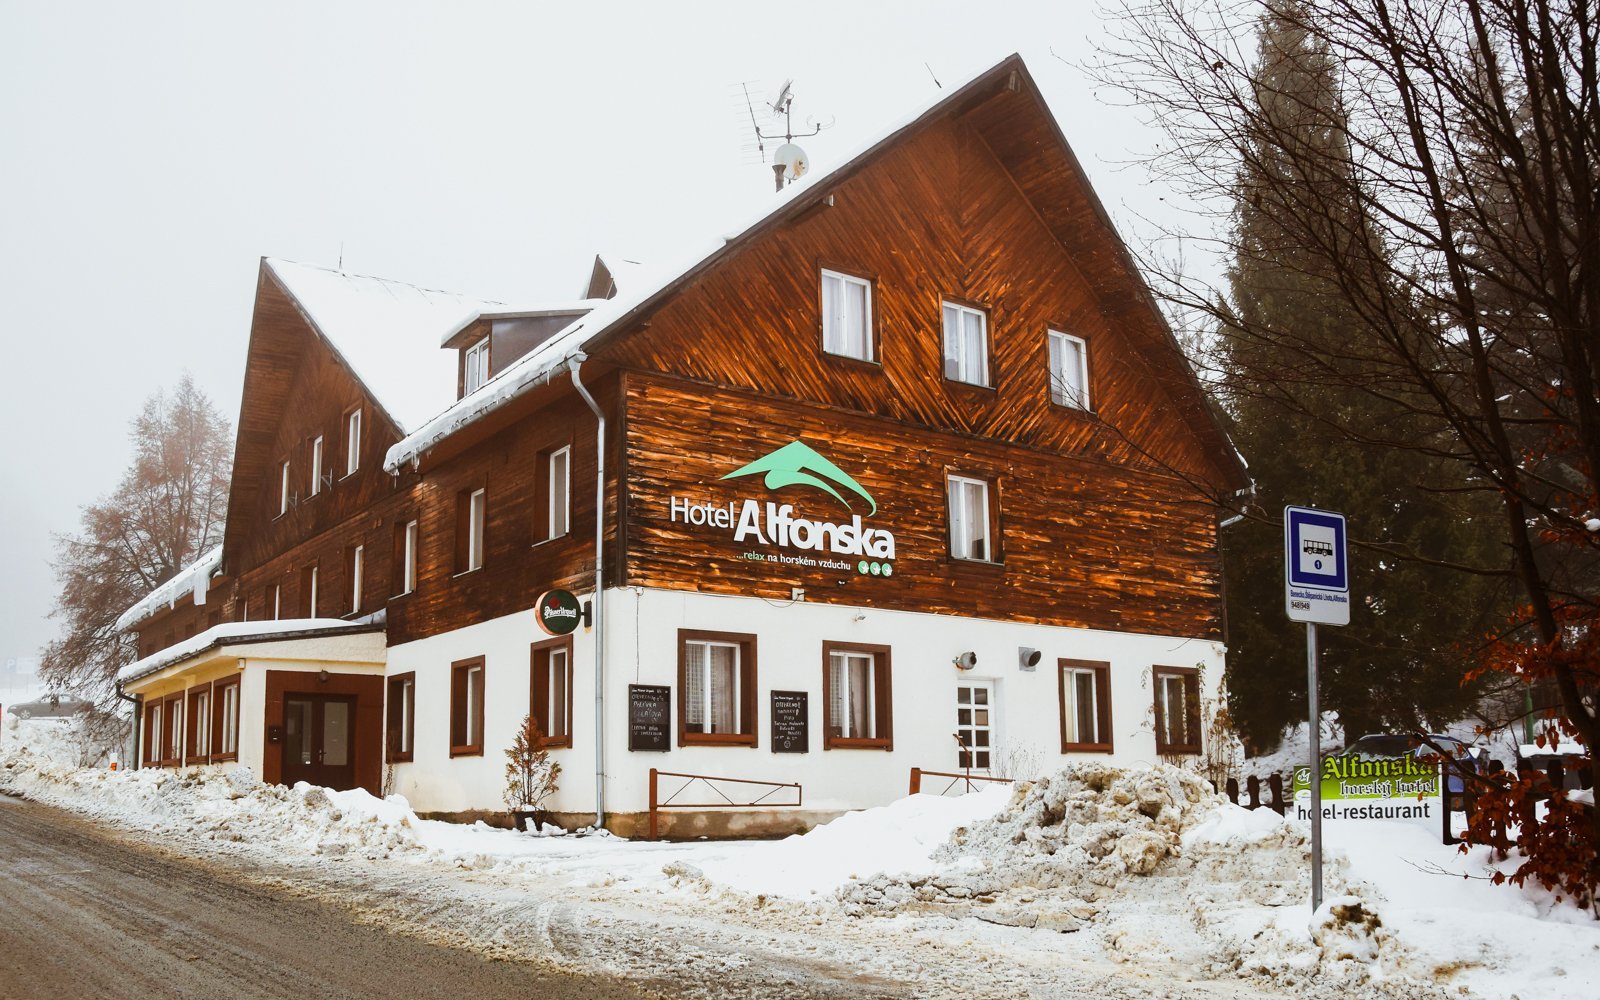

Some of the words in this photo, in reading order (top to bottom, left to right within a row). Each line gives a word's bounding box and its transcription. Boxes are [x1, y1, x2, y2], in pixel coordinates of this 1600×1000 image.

[670, 496, 734, 529] Hotel
[733, 499, 896, 560] Alfonska
[767, 554, 778, 563] na
[780, 554, 816, 567] horském
[818, 559, 851, 571] vzduchu
[1321, 753, 1433, 779] Alfonska
[1340, 779, 1392, 798] horský
[1395, 778, 1437, 797] hotel
[1298, 803, 1430, 820] hel-restaurant
